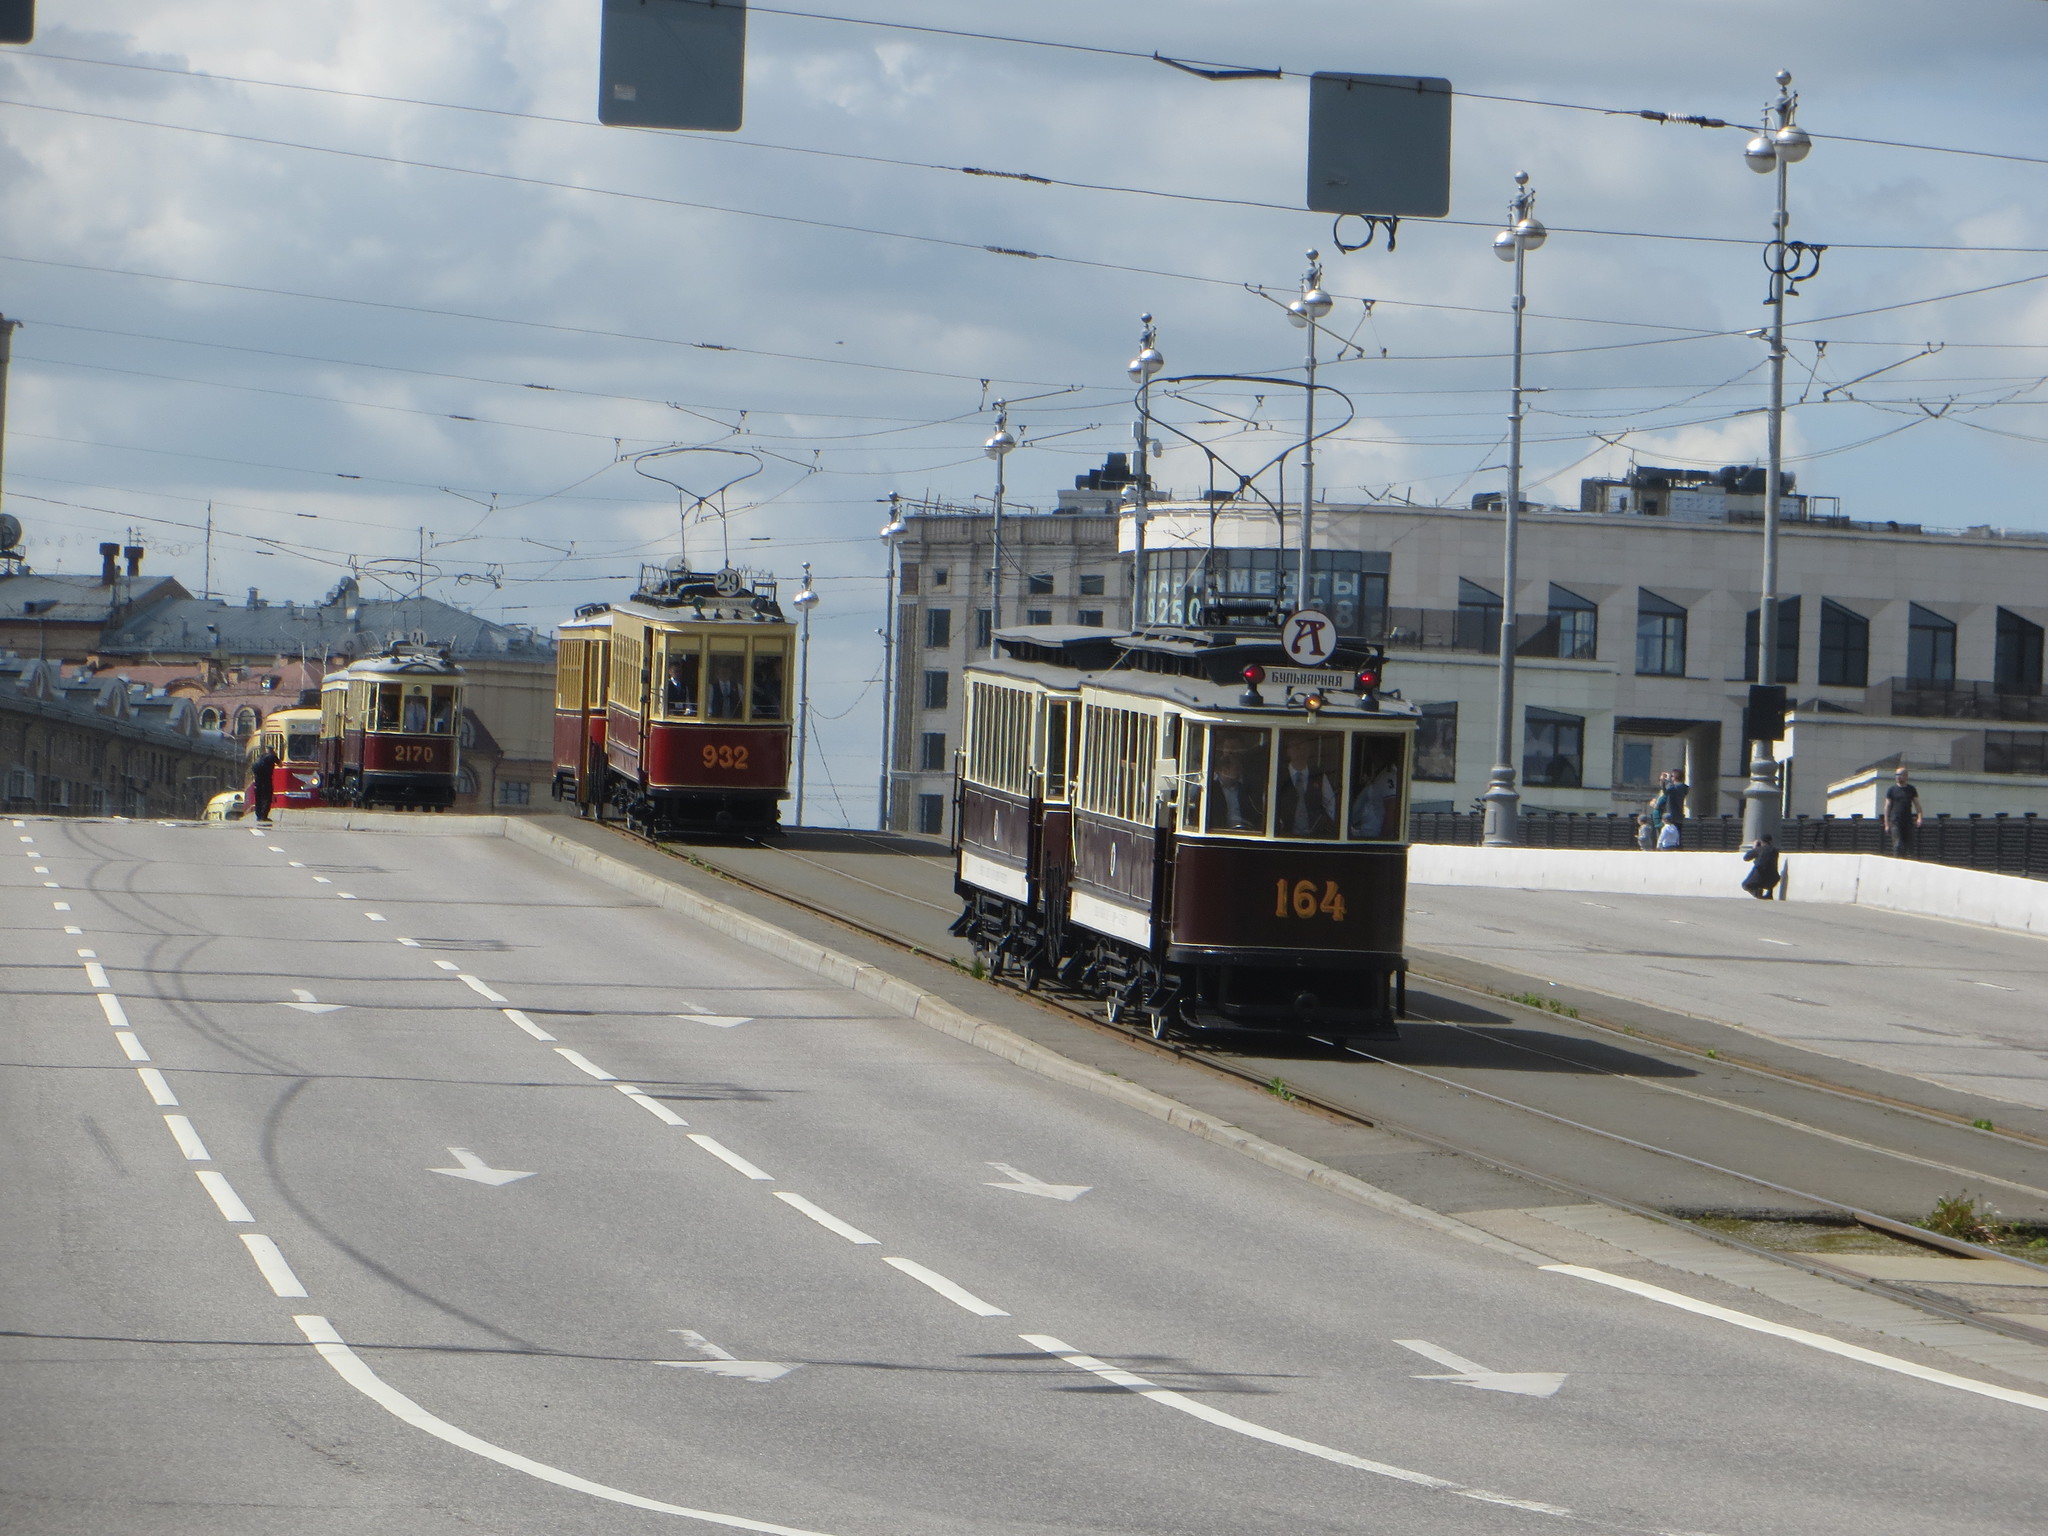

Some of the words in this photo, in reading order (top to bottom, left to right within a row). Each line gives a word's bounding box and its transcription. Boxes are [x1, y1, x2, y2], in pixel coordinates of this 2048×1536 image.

[717, 573, 740, 592] 29
[1146, 570, 1359, 597] ПАРТАМЕНТЫ
[1271, 671, 1343, 687] БУЛЬВАРНАЯ
[395, 745, 433, 763] 2170
[702, 744, 749, 770] 932
[1275, 878, 1348, 922] 164
